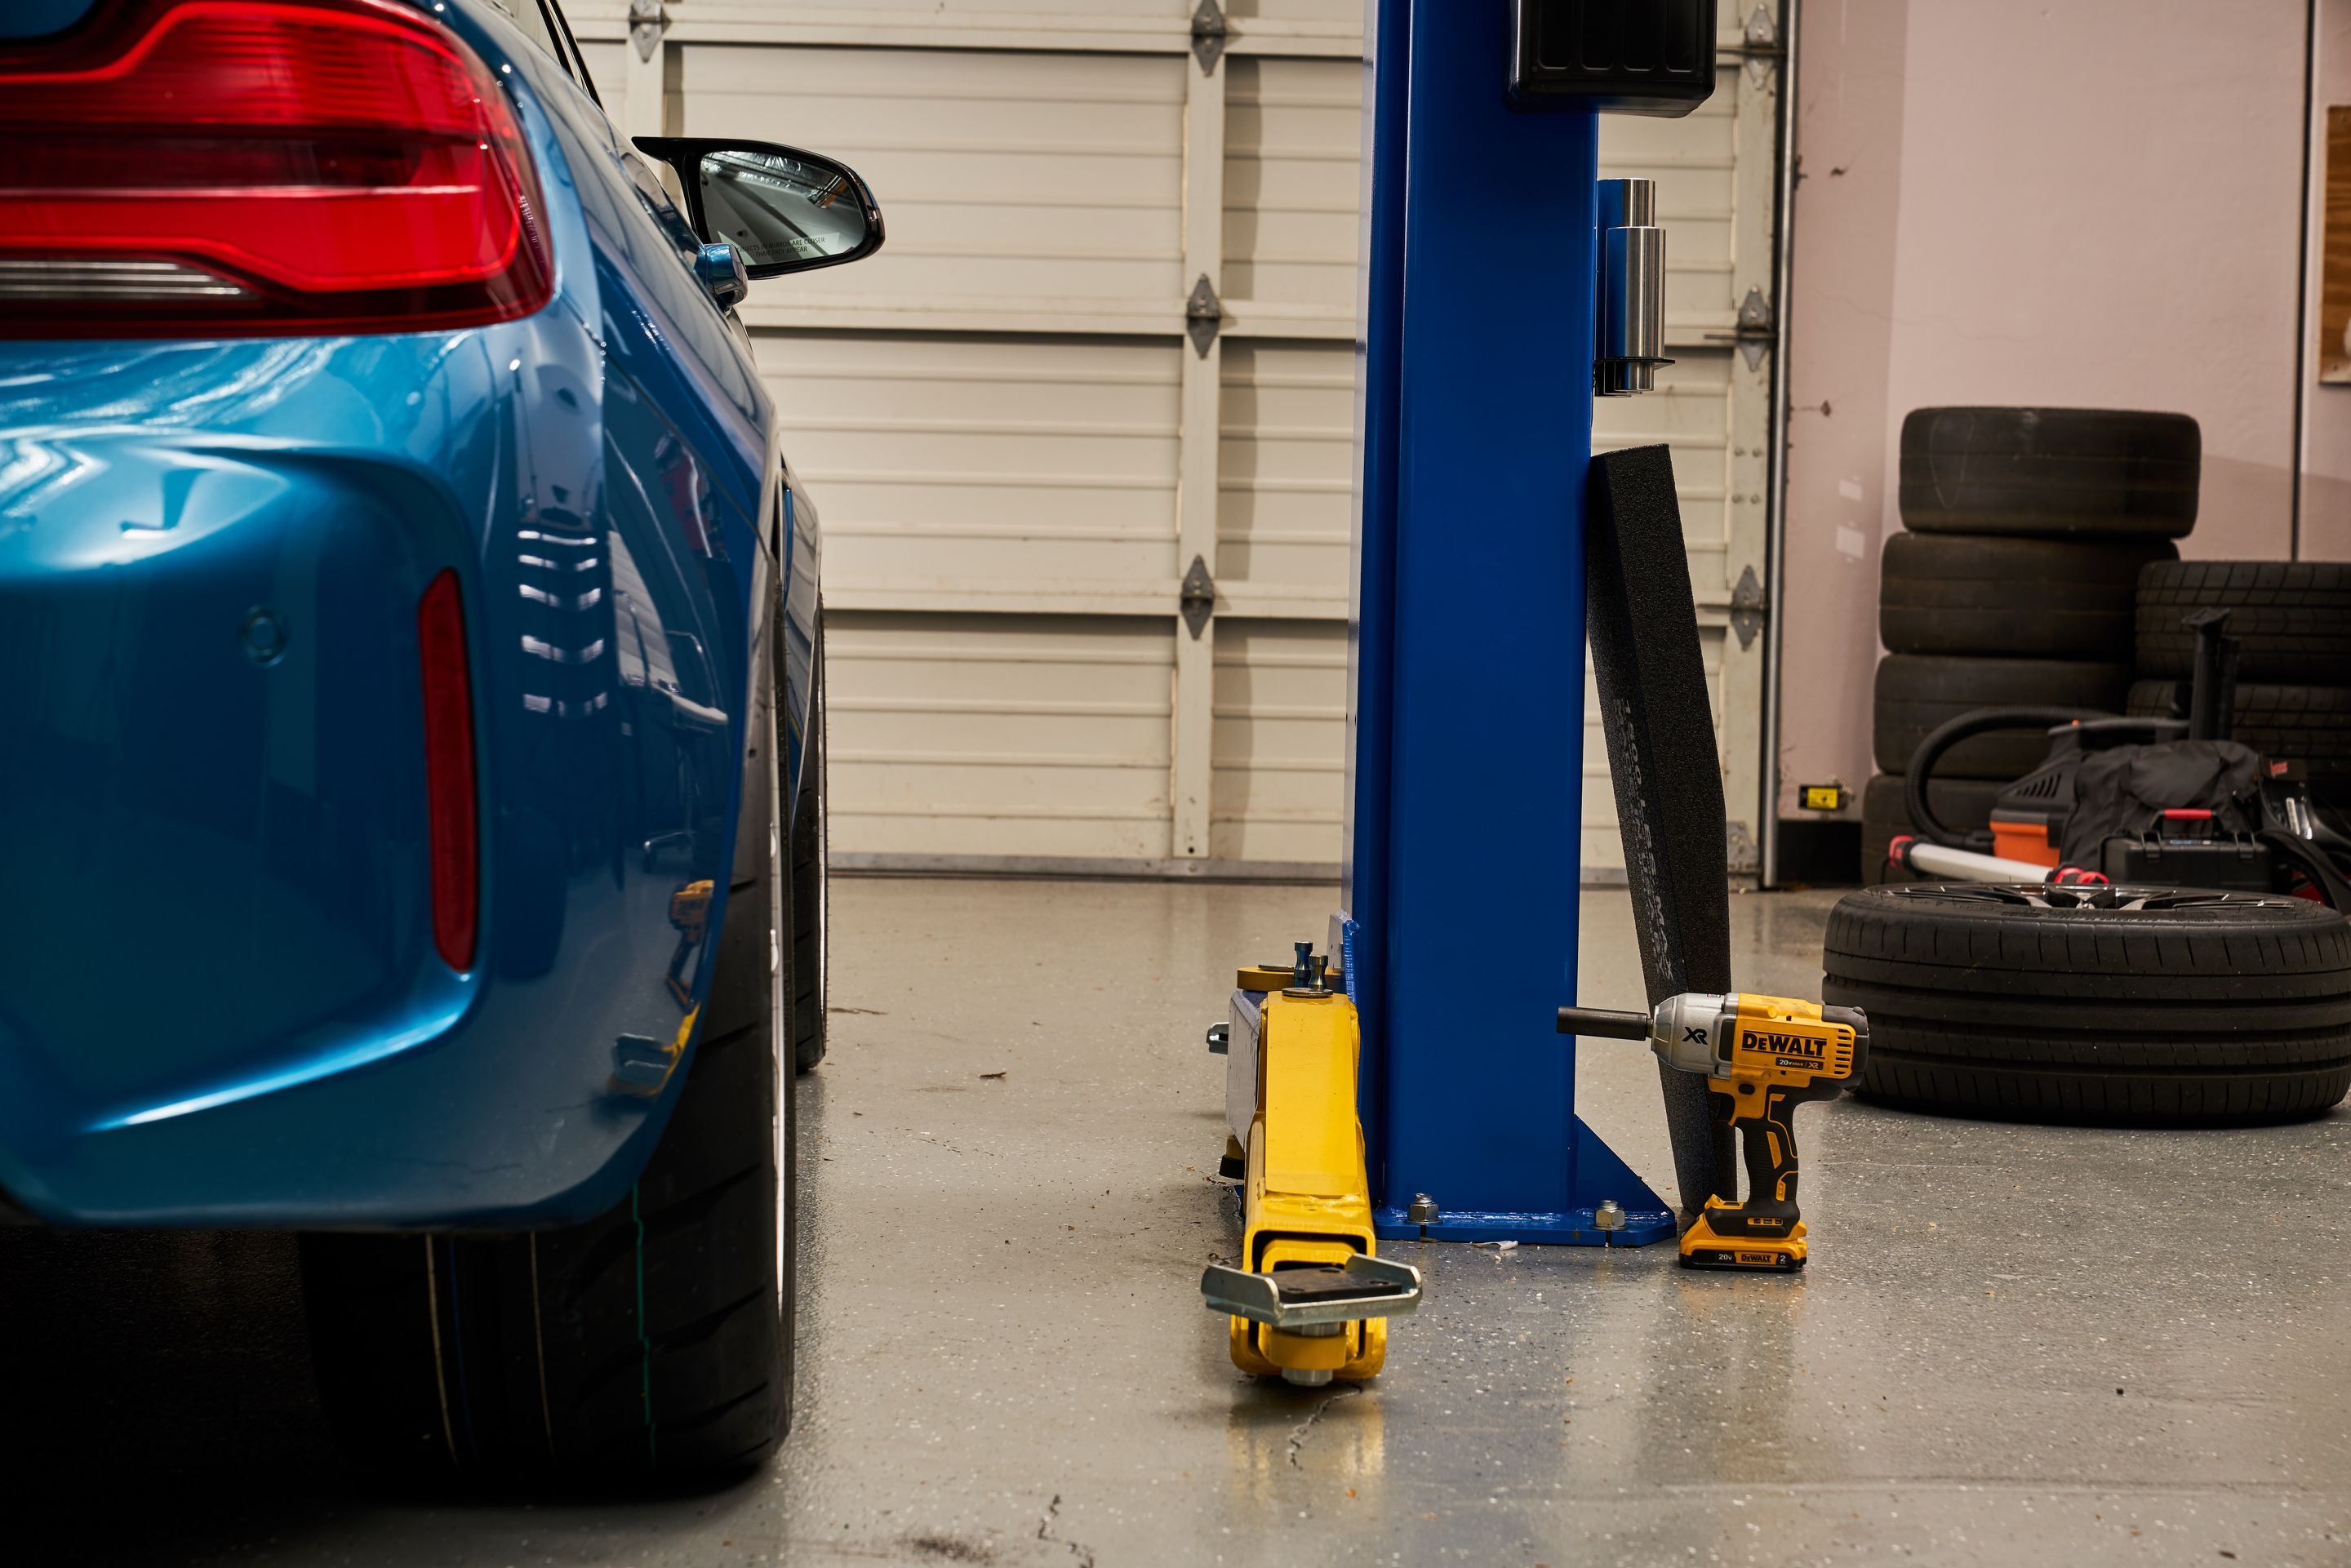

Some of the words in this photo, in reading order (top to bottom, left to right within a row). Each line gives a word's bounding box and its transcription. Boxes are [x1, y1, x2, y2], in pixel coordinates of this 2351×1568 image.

[738, 244, 762, 253] OBJECTS
[769, 241, 791, 249] MIRROR
[803, 236, 825, 245] CLOSER
[756, 249, 771, 257] THAN
[771, 247, 785, 255] THEY
[786, 245, 808, 254] APPEAR
[1682, 1026, 1709, 1045] XR
[1742, 1033, 1827, 1056] DEWALT
[1807, 1061, 1819, 1069] XR
